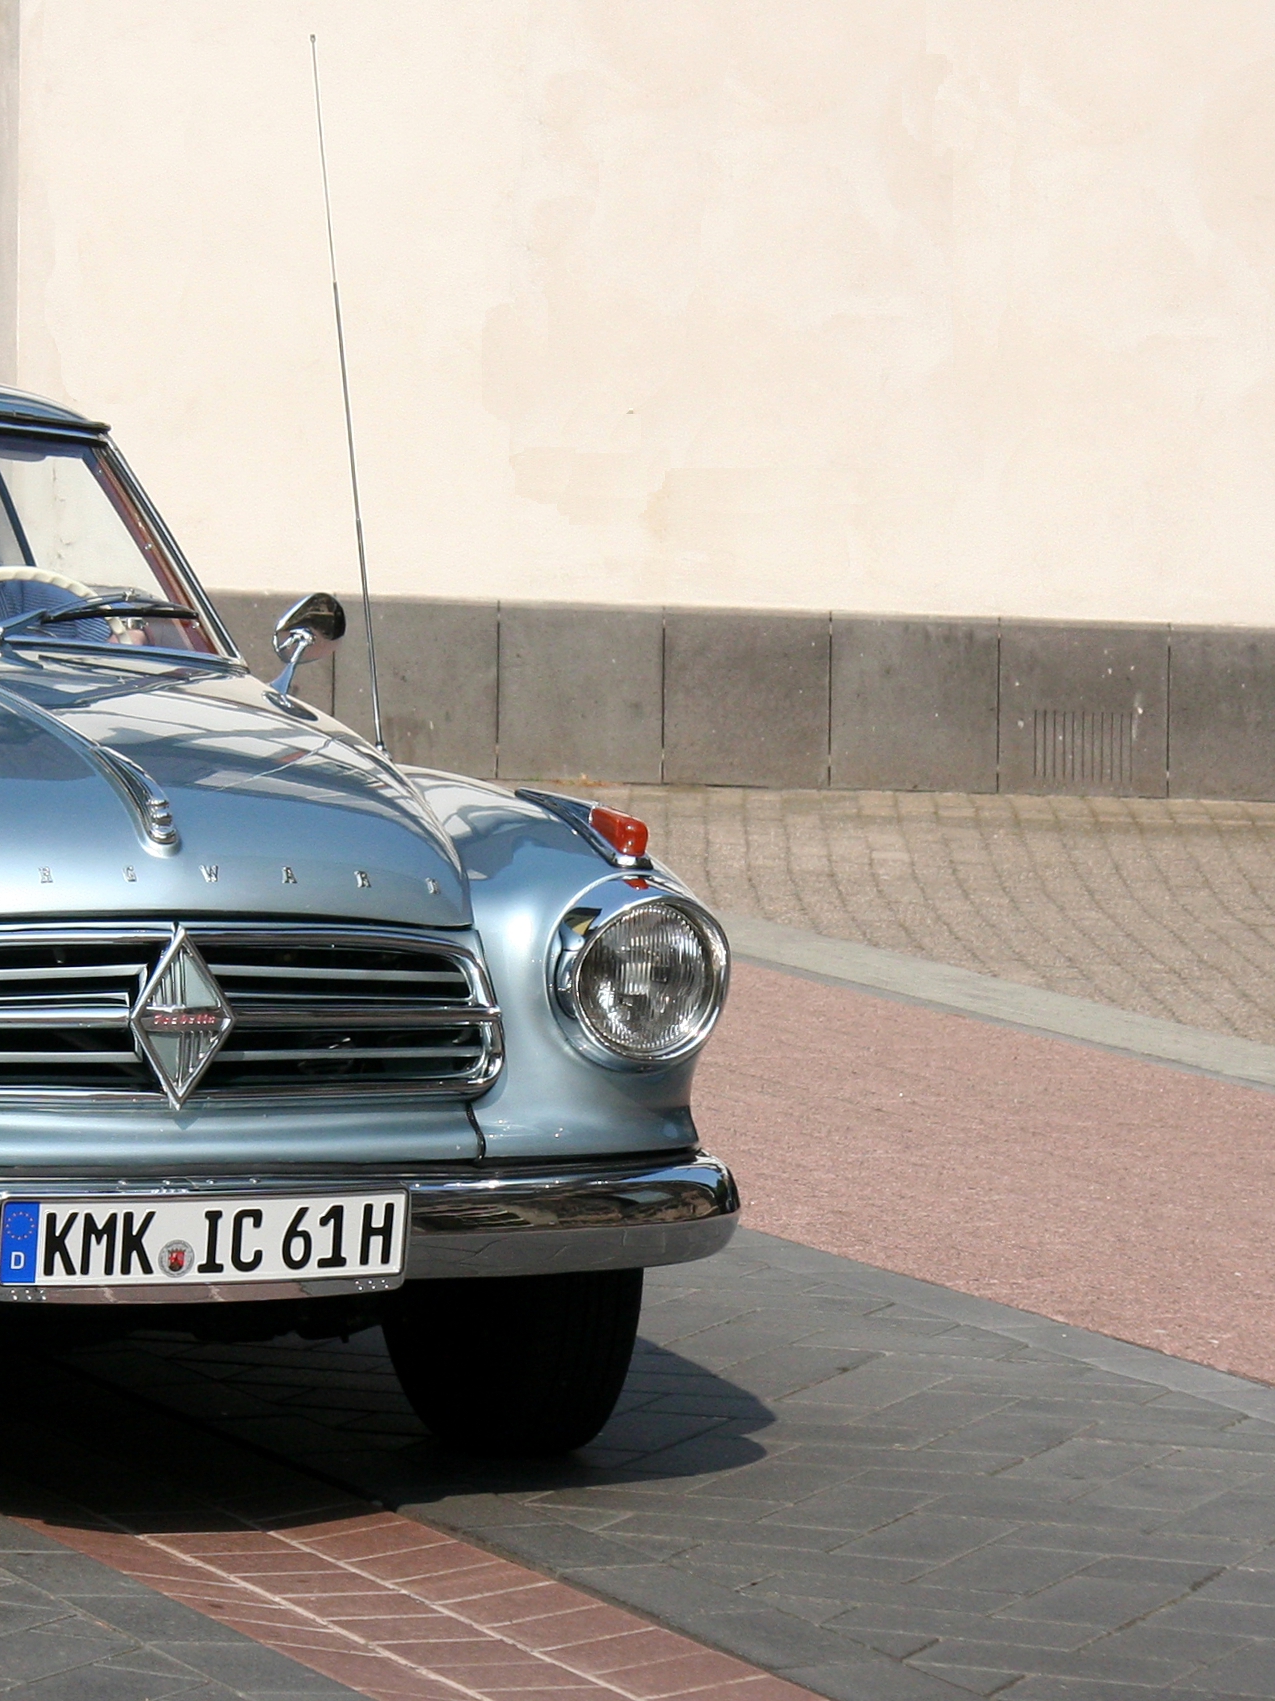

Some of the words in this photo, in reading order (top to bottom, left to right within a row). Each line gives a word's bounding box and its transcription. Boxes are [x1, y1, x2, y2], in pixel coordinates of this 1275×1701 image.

[10, 1251, 26, 1270] D
[43, 1211, 157, 1276] KMK
[197, 1208, 263, 1273] IC
[282, 1202, 395, 1270] 61H
